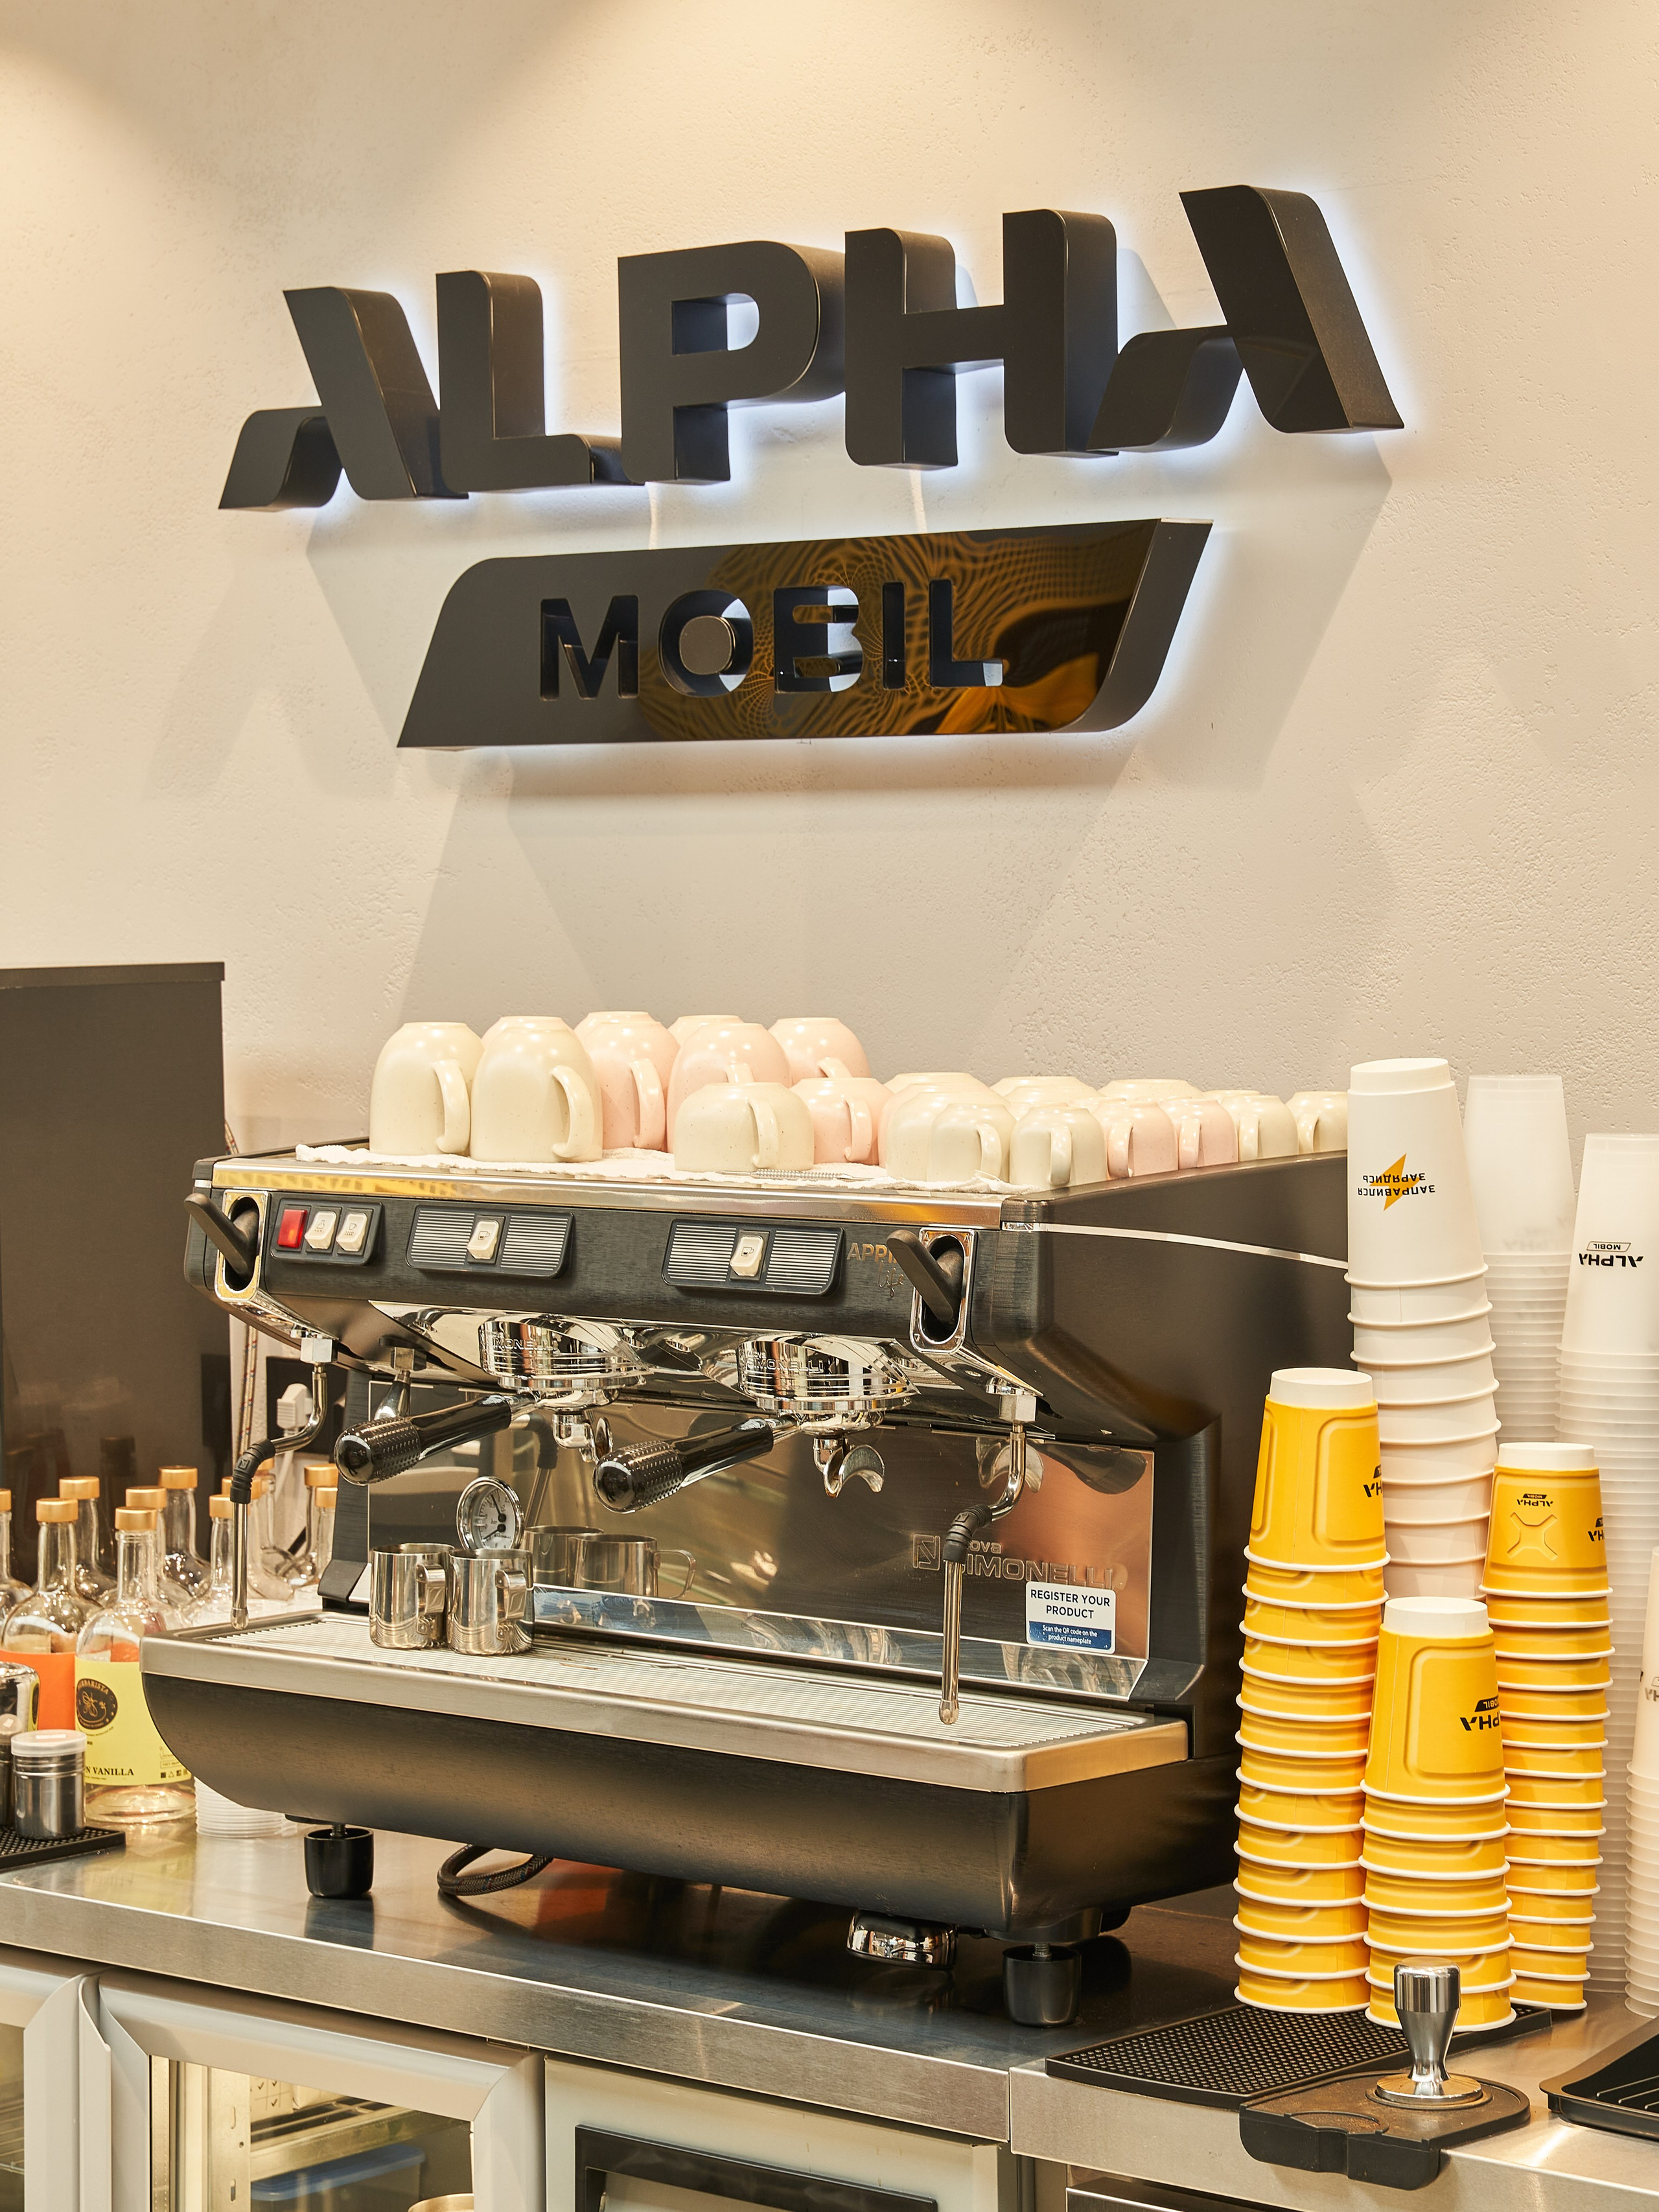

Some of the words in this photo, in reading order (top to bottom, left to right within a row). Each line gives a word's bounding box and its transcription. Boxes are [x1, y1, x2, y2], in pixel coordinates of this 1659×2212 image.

[219, 185, 1404, 511] ALPHA
[539, 578, 1004, 701] MOBIL
[1362, 1172, 1426, 1183] ЗАРЯДИСЬ
[1357, 1185, 1436, 1196] ЗАПРАВИЛСЯ
[846, 1242, 898, 1264] APPI
[1578, 1253, 1644, 1268] ALPHA
[1516, 1498, 1554, 1508] ALPHA
[1030, 1589, 1079, 1603] REGISTER
[1081, 1594, 1111, 1607] YOUR
[1046, 1605, 1095, 1619] PRODUCT
[1042, 1624, 1054, 1633] Scan
[1048, 1634, 1067, 1642] product
[1067, 1636, 1092, 1645] nameplate
[1483, 1699, 1499, 1708] OBIL
[93, 1767, 134, 1776] VANILLA
